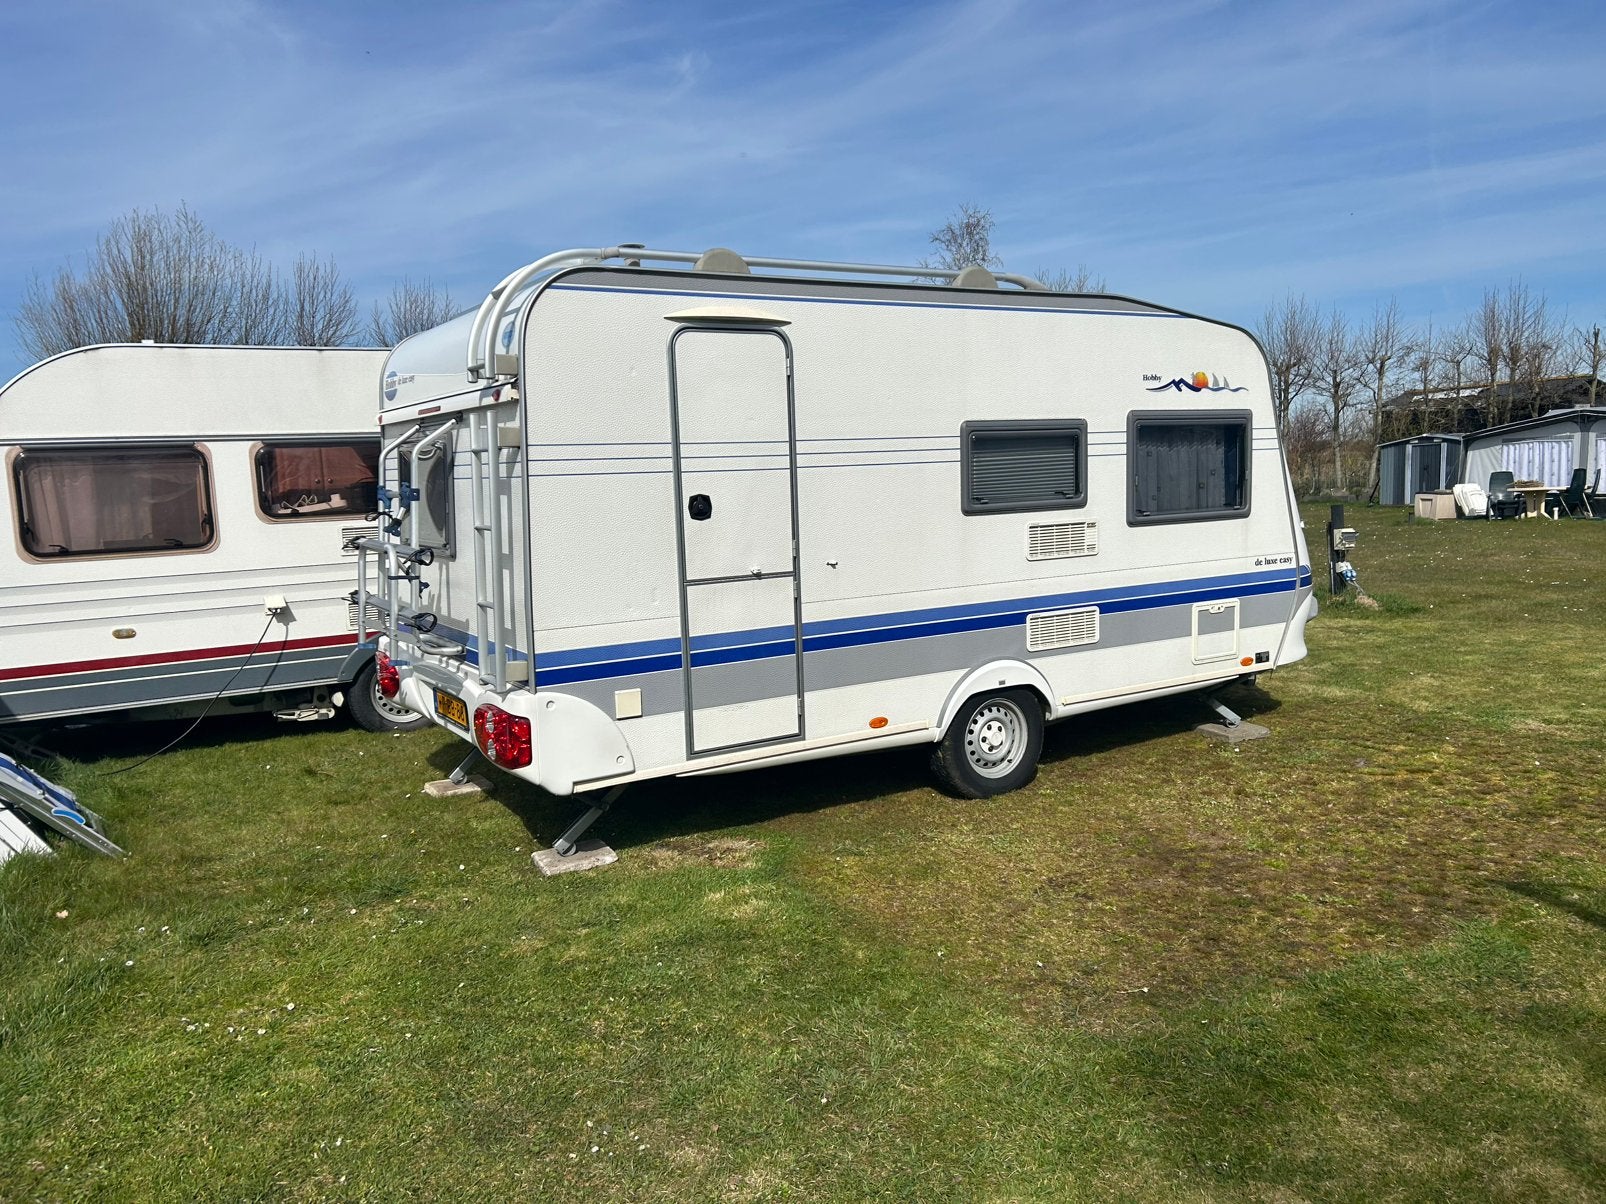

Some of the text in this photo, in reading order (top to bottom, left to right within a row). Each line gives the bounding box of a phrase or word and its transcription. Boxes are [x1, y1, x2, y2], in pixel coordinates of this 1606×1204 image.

[1142, 374, 1162, 383] Hobby
[1254, 556, 1293, 566] de luxe easy
